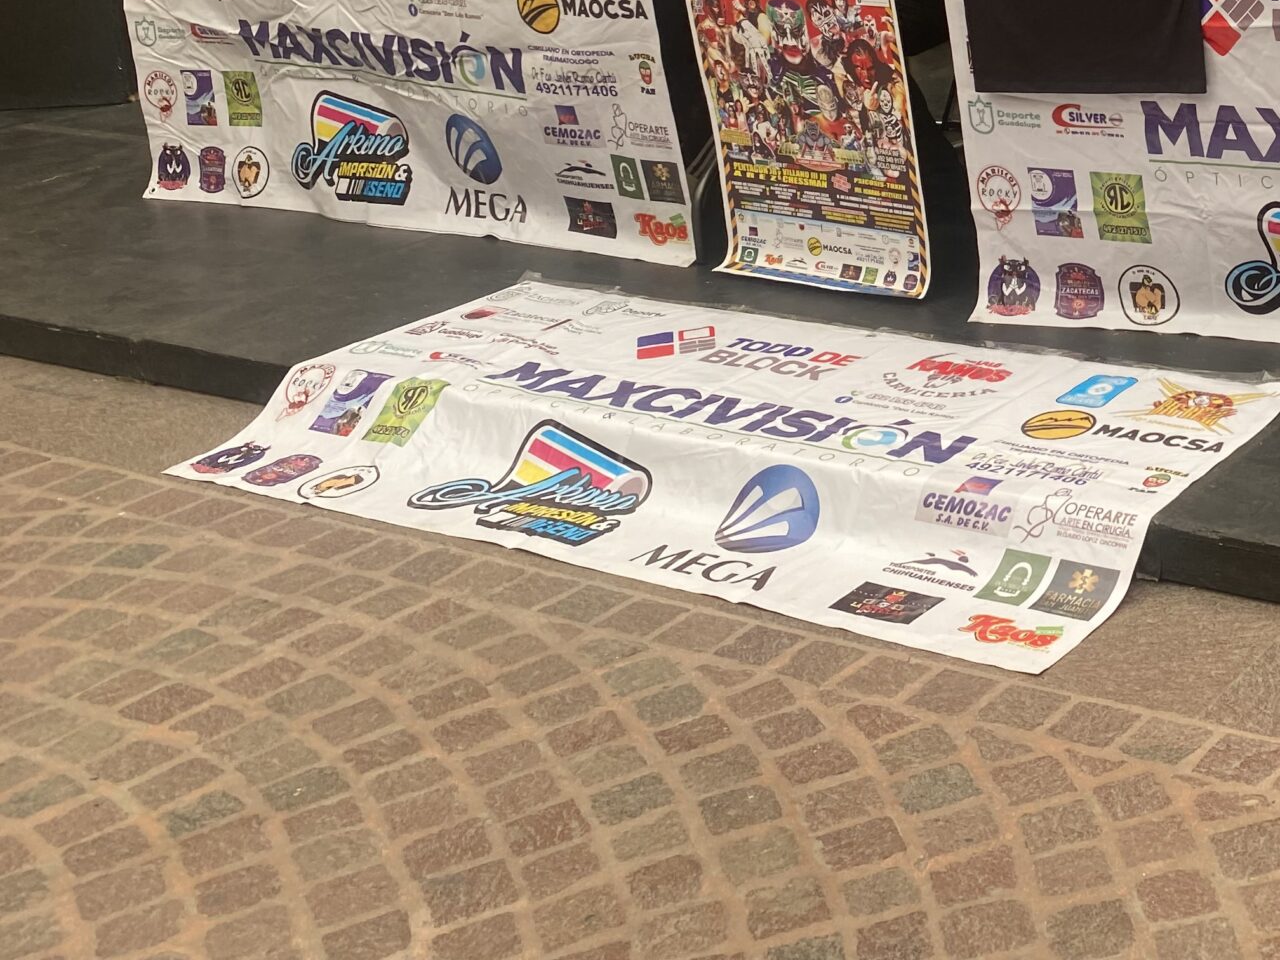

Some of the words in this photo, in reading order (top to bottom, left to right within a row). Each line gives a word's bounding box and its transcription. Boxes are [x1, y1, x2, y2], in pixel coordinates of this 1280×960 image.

[238, 18, 527, 94] MAXCIVISIÓN
[535, 81, 619, 98] 4921171406
[996, 109, 1041, 121] Deporte
[1068, 111, 1108, 124] SILVER
[543, 126, 601, 140] CEMOZAC
[627, 120, 670, 137] OPERARTE
[395, 164, 409, 181] &
[979, 167, 1018, 188] MARISCOS
[445, 186, 527, 224] MEGA
[981, 188, 1018, 200] ROCKY
[634, 212, 690, 246] Kaos
[822, 244, 853, 256] MAOCSA
[1060, 287, 1100, 296] ZACATECAS
[725, 336, 815, 358] TODO
[808, 350, 863, 367] DE
[698, 348, 837, 381] BLOCK
[905, 358, 1013, 383] RAMOS
[882, 371, 998, 398] CARNICERIA
[484, 361, 978, 465] MAXCIVISIÓN
[1091, 423, 1226, 454] MAOCSA
[1050, 448, 1069, 457] EN
[1071, 451, 1130, 466] ORTOPEDIA
[965, 460, 1089, 486] 4921171406
[922, 492, 1012, 523] CEMOZAC
[1063, 500, 1139, 527] OPERARTE
[935, 513, 954, 525] S.A.
[956, 517, 971, 528] DE
[972, 519, 990, 532] C.V.
[1059, 516, 1082, 530] ARTE
[1081, 519, 1094, 531] EN
[1094, 522, 1132, 539] CIRUGÍA
[629, 543, 778, 592] MEGA
[882, 566, 976, 593] CHIHUAHUENSES
[888, 561, 937, 577] TRANSPORTES
